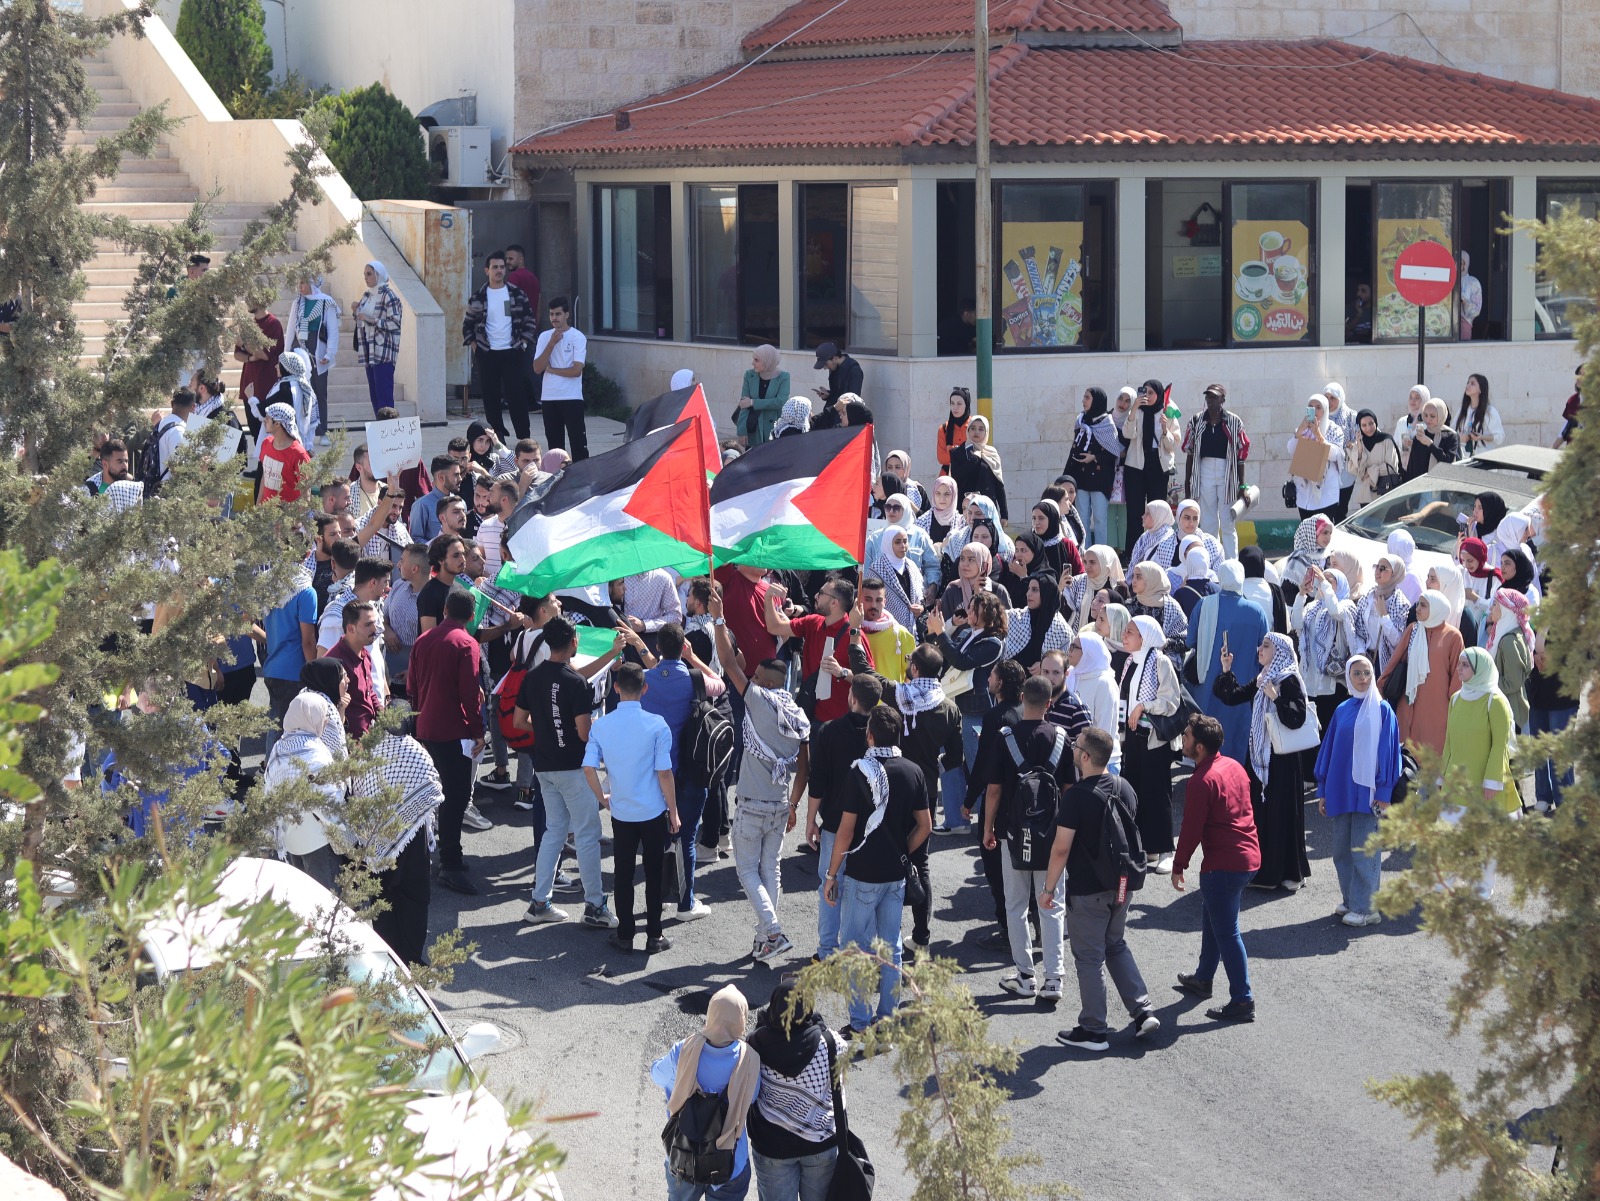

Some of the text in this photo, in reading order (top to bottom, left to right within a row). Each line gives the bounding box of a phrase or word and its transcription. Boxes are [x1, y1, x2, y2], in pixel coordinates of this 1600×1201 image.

[441, 213, 453, 228] 5
[1009, 311, 1028, 324] Doritos
[1266, 312, 1291, 331] العميد
[1291, 315, 1304, 330] بن
